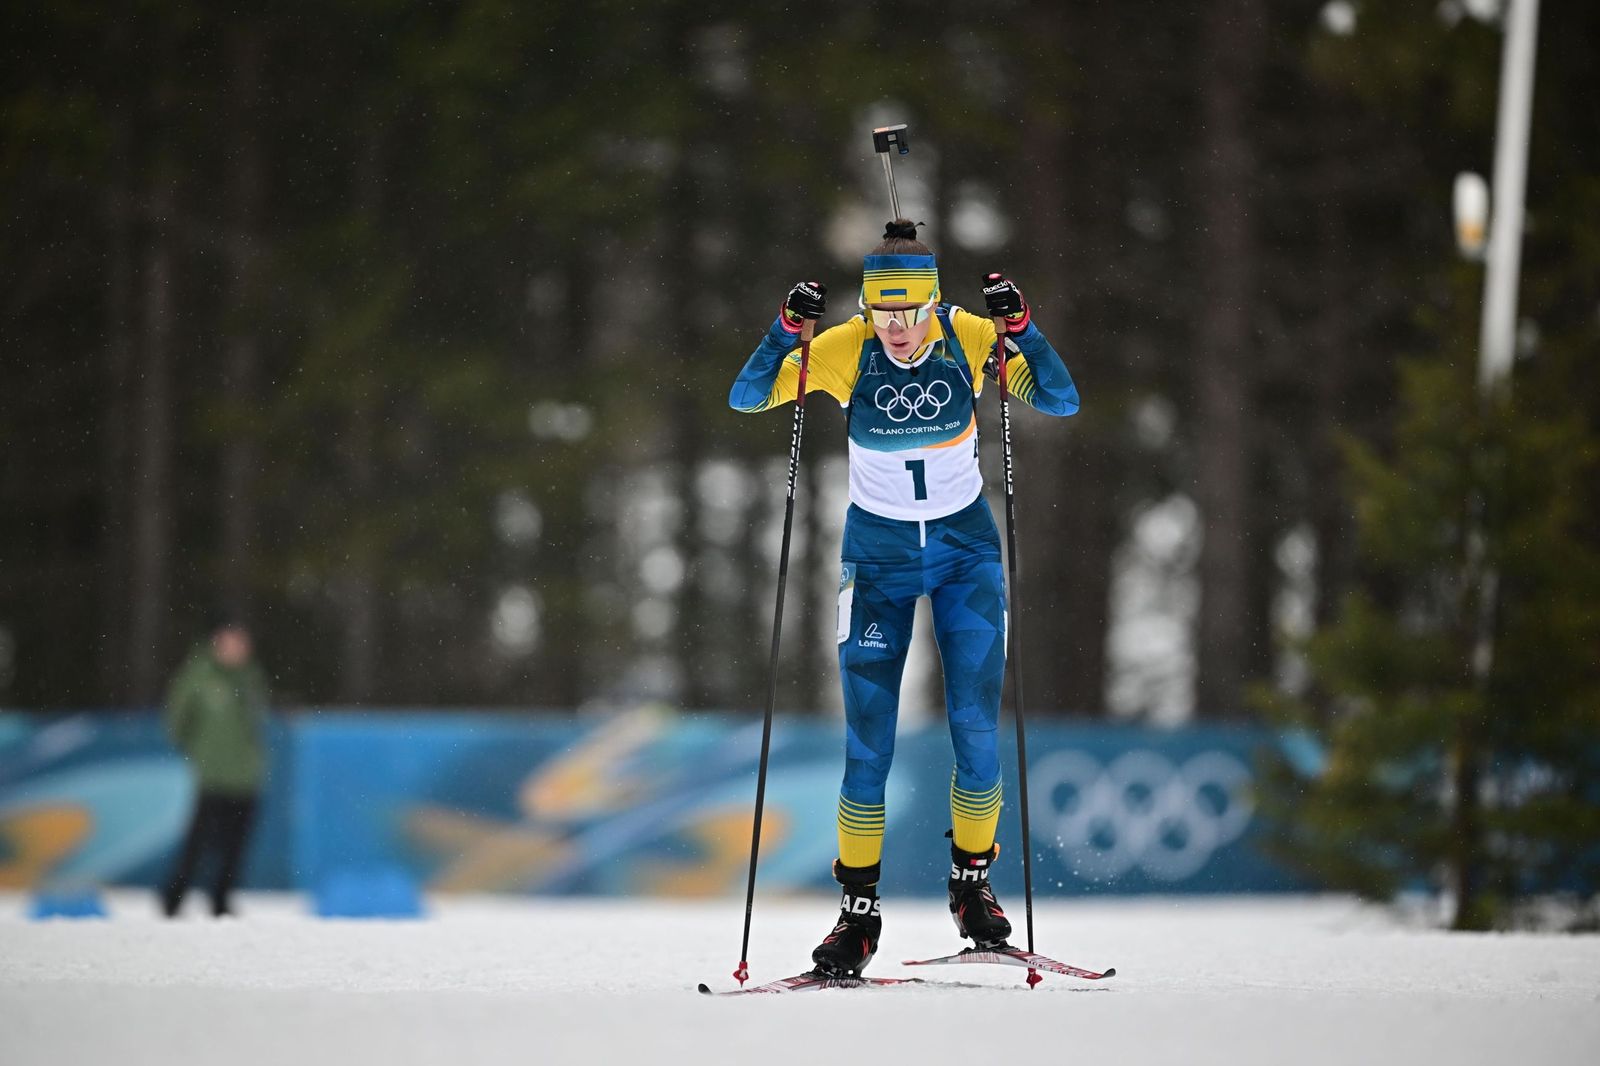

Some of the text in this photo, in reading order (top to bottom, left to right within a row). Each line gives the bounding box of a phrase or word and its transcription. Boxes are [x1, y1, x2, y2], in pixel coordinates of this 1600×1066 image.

[869, 420, 961, 436] MILANO CORTINA 2026
[905, 459, 928, 501] 1
[858, 639, 888, 649] Löffler
